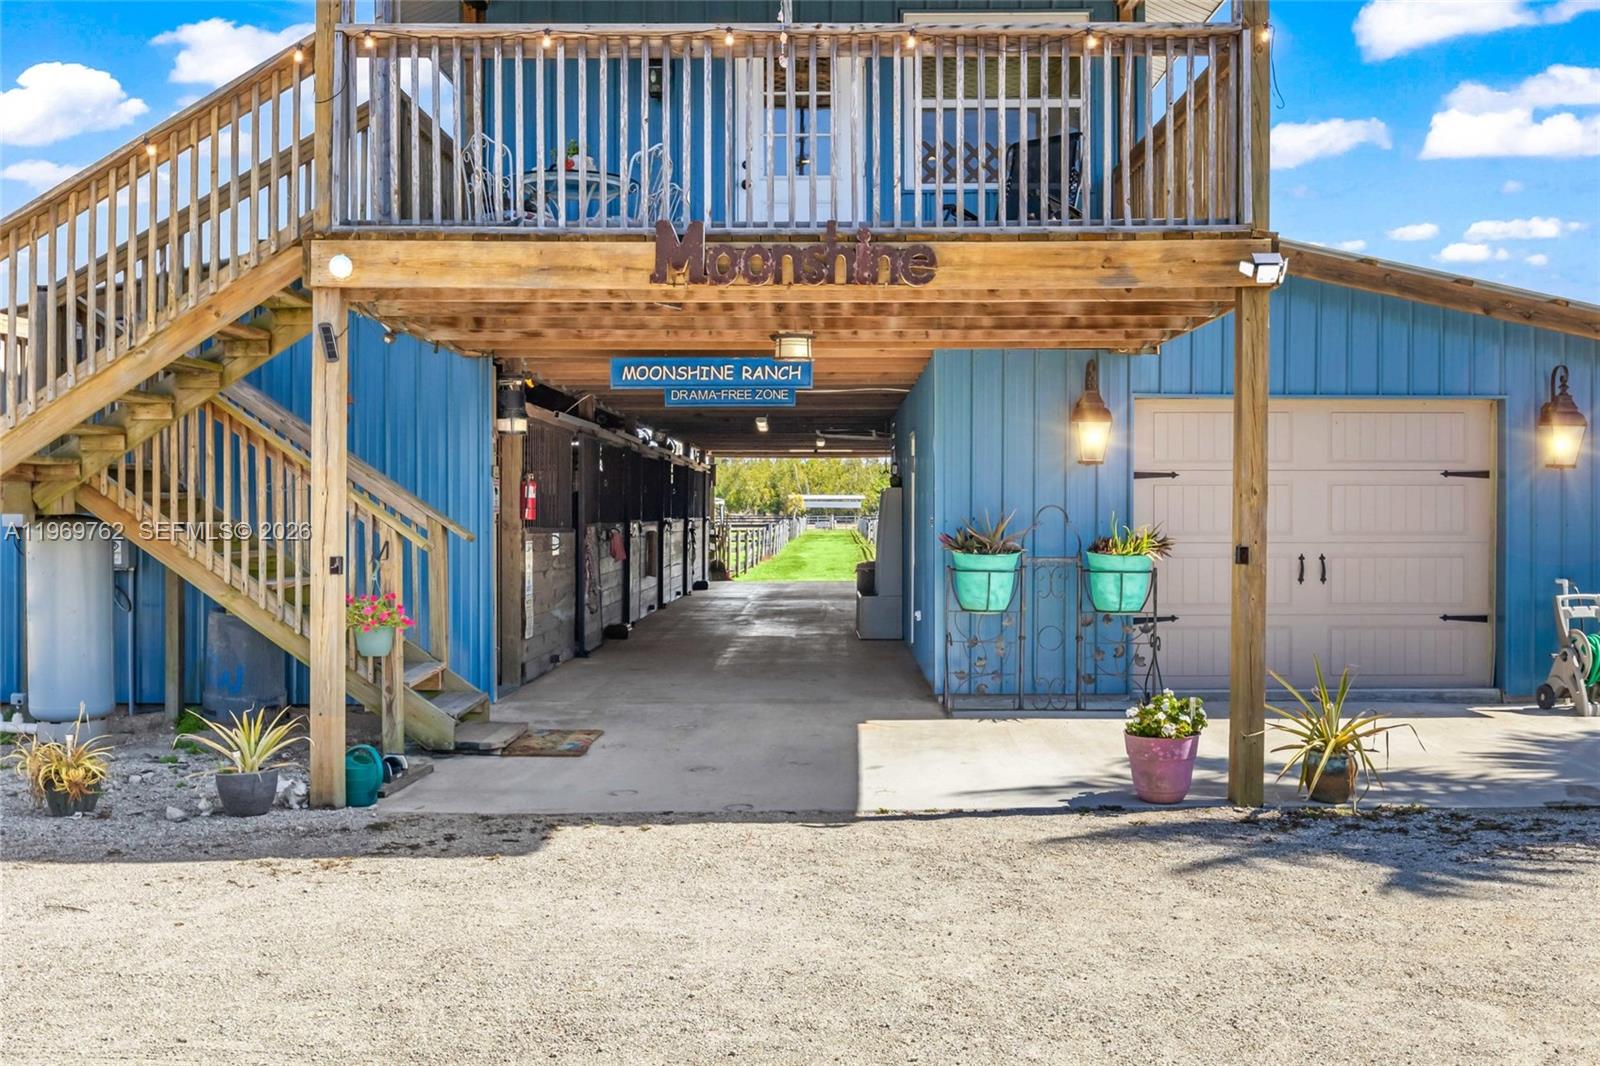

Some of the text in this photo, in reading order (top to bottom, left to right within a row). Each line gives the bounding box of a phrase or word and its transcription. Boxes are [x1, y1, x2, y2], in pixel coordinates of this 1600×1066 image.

[650, 219, 938, 287] Moonshine
[621, 364, 802, 382] MOONSHINE RANCH
[670, 388, 789, 401] DRAMA-FREE ZONE
